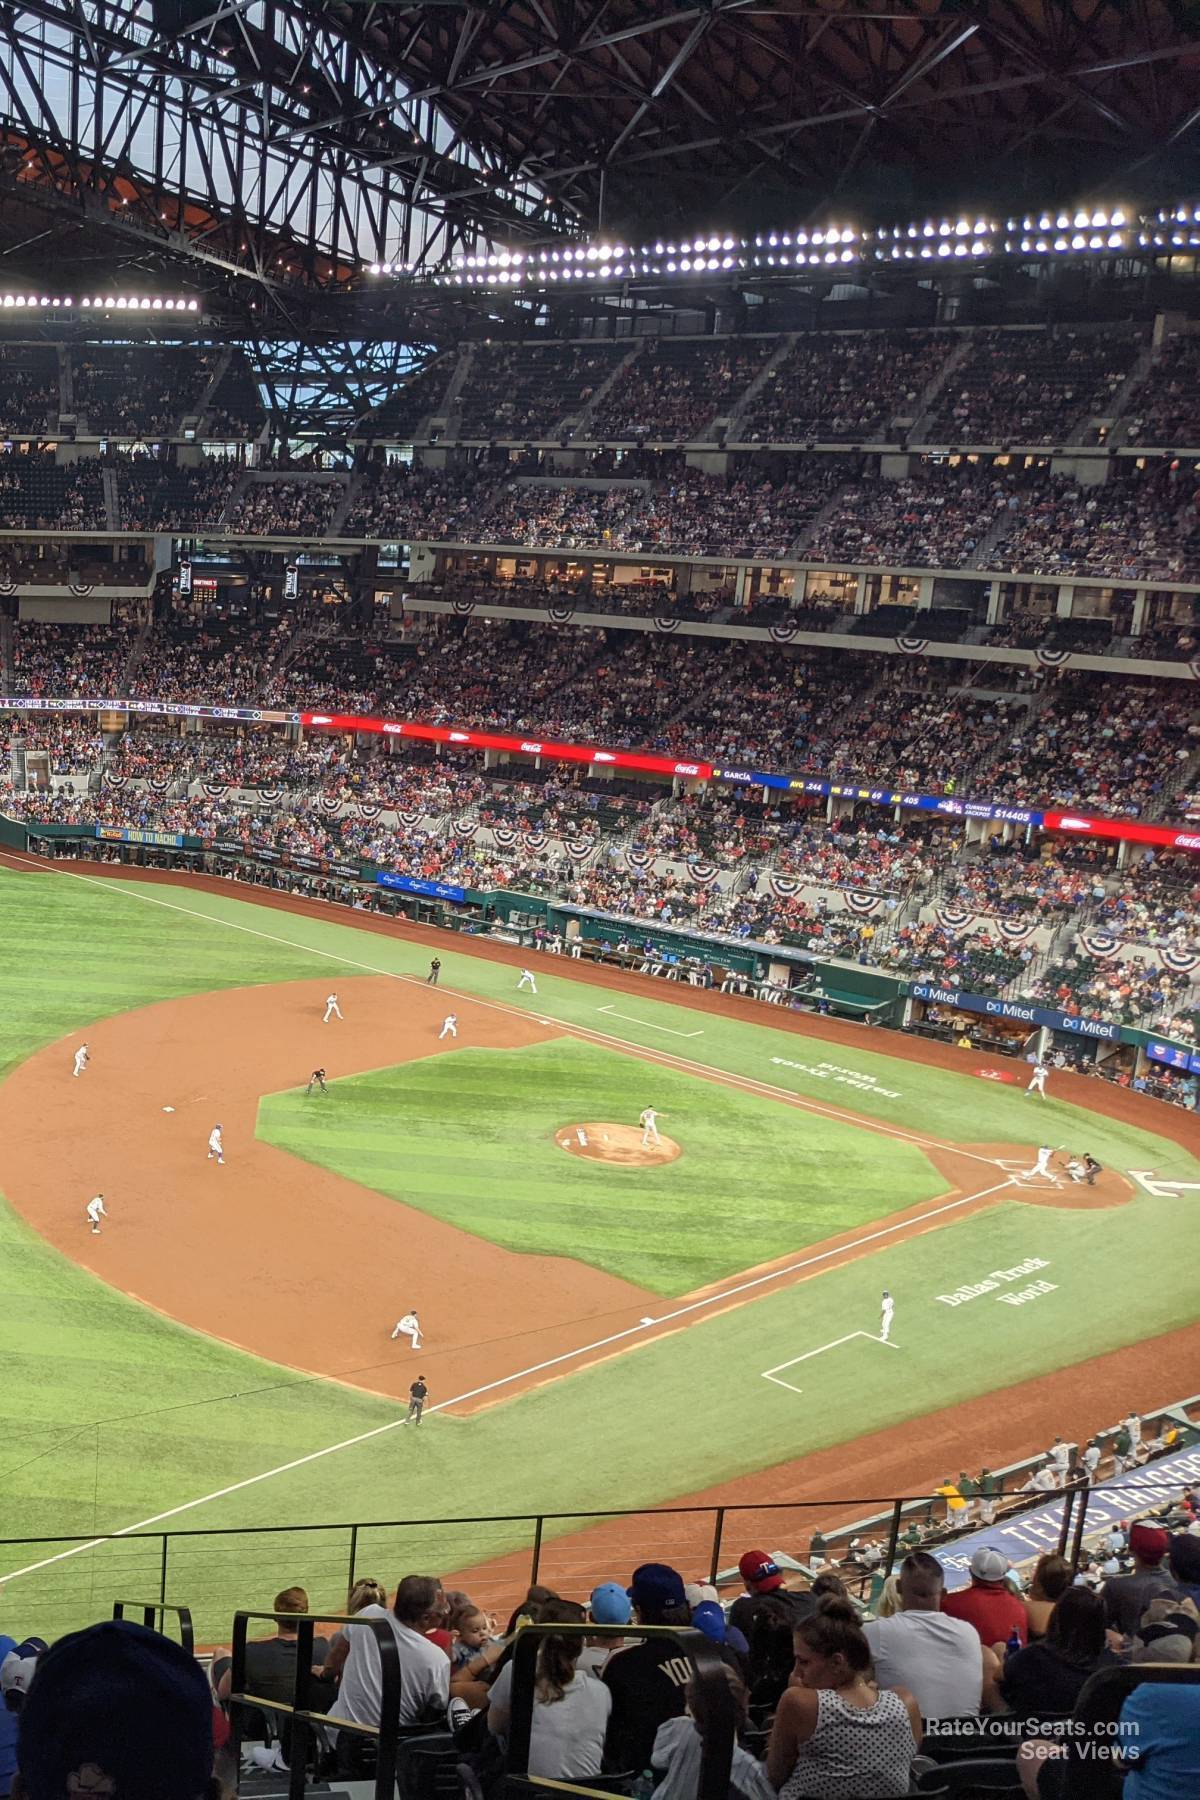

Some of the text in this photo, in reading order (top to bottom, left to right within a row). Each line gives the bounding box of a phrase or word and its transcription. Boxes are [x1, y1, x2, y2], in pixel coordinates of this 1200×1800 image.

[806, 781, 822, 792] .244
[843, 788, 853, 796] 25
[871, 790, 882, 800] 69
[904, 795, 919, 805] 405
[965, 803, 991, 813] CURRENT
[965, 809, 991, 818] JACKPOT
[994, 810, 1030, 822] $14405
[128, 830, 143, 842] HOW
[145, 832, 154, 843] TO
[155, 833, 176, 846] NACHO
[928, 988, 959, 1005] Mitel
[1002, 1004, 1035, 1020] Mitel
[1080, 1020, 1115, 1038] Mitel
[936, 1257, 1051, 1307] Dallas Truck
[996, 1279, 1060, 1307] World
